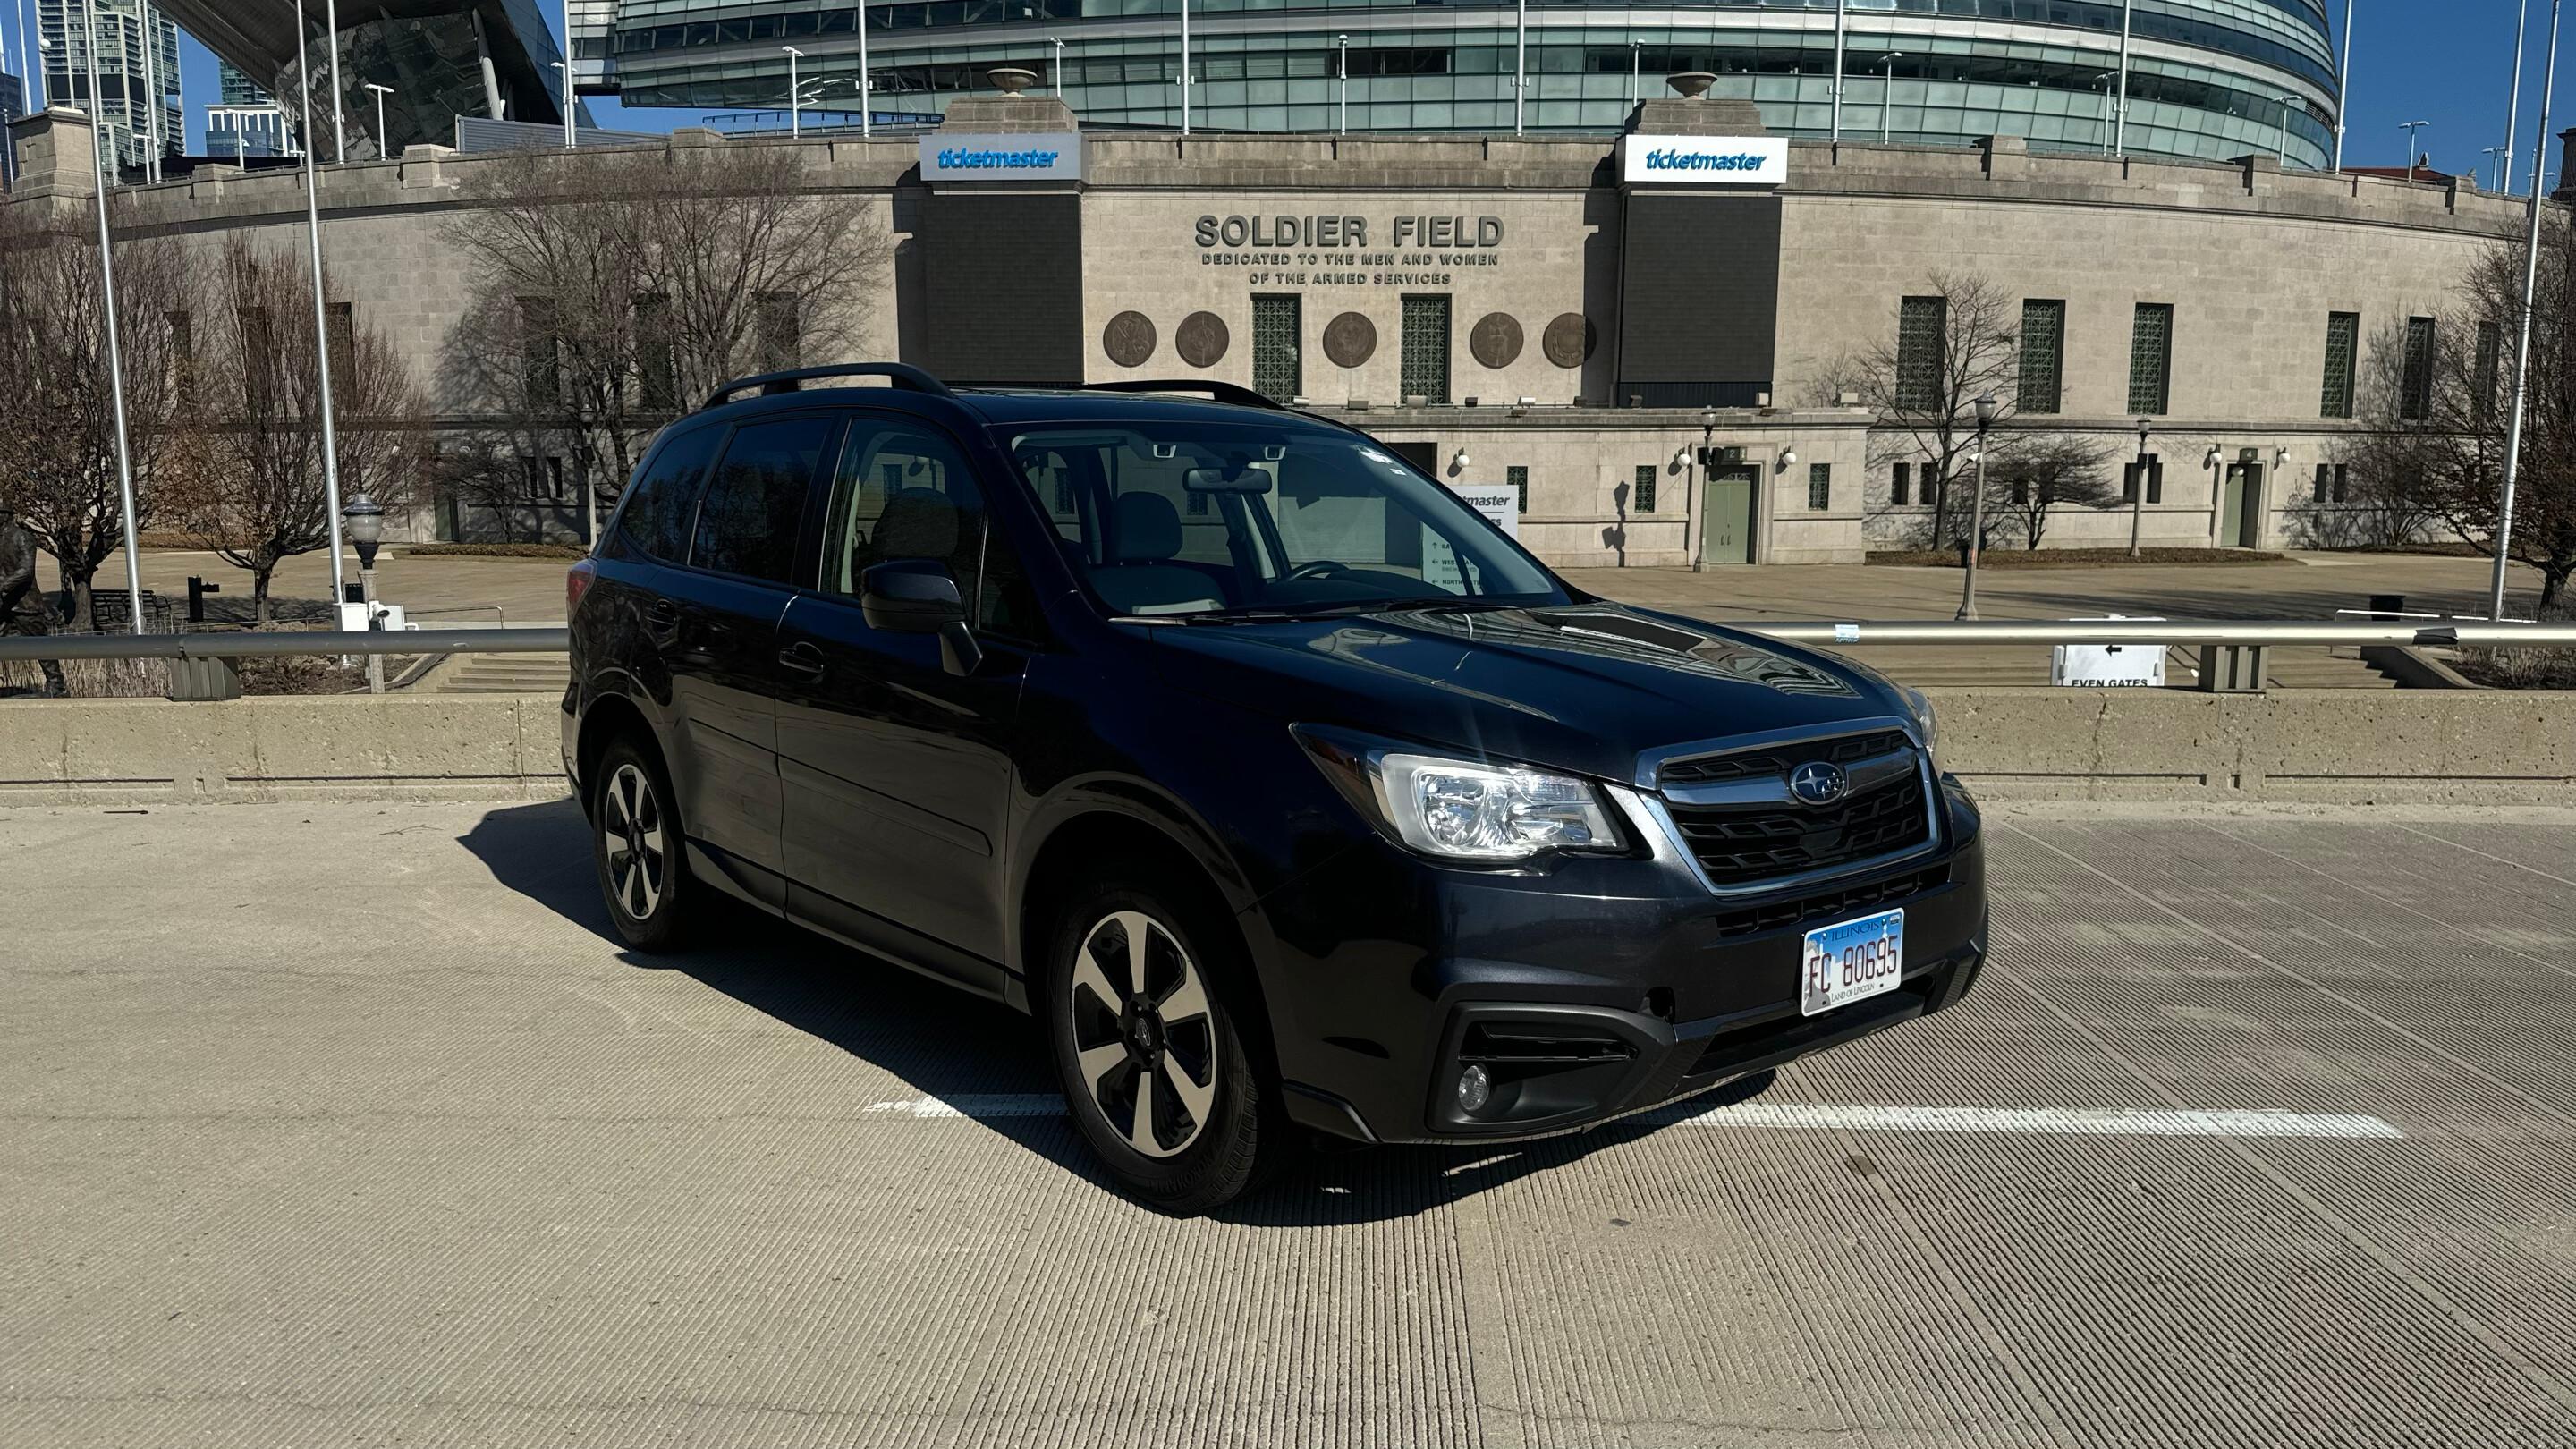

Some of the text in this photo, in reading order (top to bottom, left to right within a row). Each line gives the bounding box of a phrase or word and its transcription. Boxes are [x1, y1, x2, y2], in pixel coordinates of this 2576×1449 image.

[937, 148, 1058, 169] ticketmaster
[1646, 148, 1767, 171] ticketmaster
[1195, 215, 1504, 248] SOLDIER FIELD
[1201, 253, 1498, 266] DEDICATED TO THE MEN AND WOMEN
[1249, 272, 1451, 285] OF THE ARMED SERVICES
[1729, 449, 1735, 459] 2
[2246, 450, 2252, 459] 4
[2072, 679, 2148, 687] EVEN GATES
[1832, 921, 1879, 941] ILLINOIS
[1810, 935, 1898, 997] FC 80695
[1831, 983, 1875, 1002] LAND OF LINCOLN
